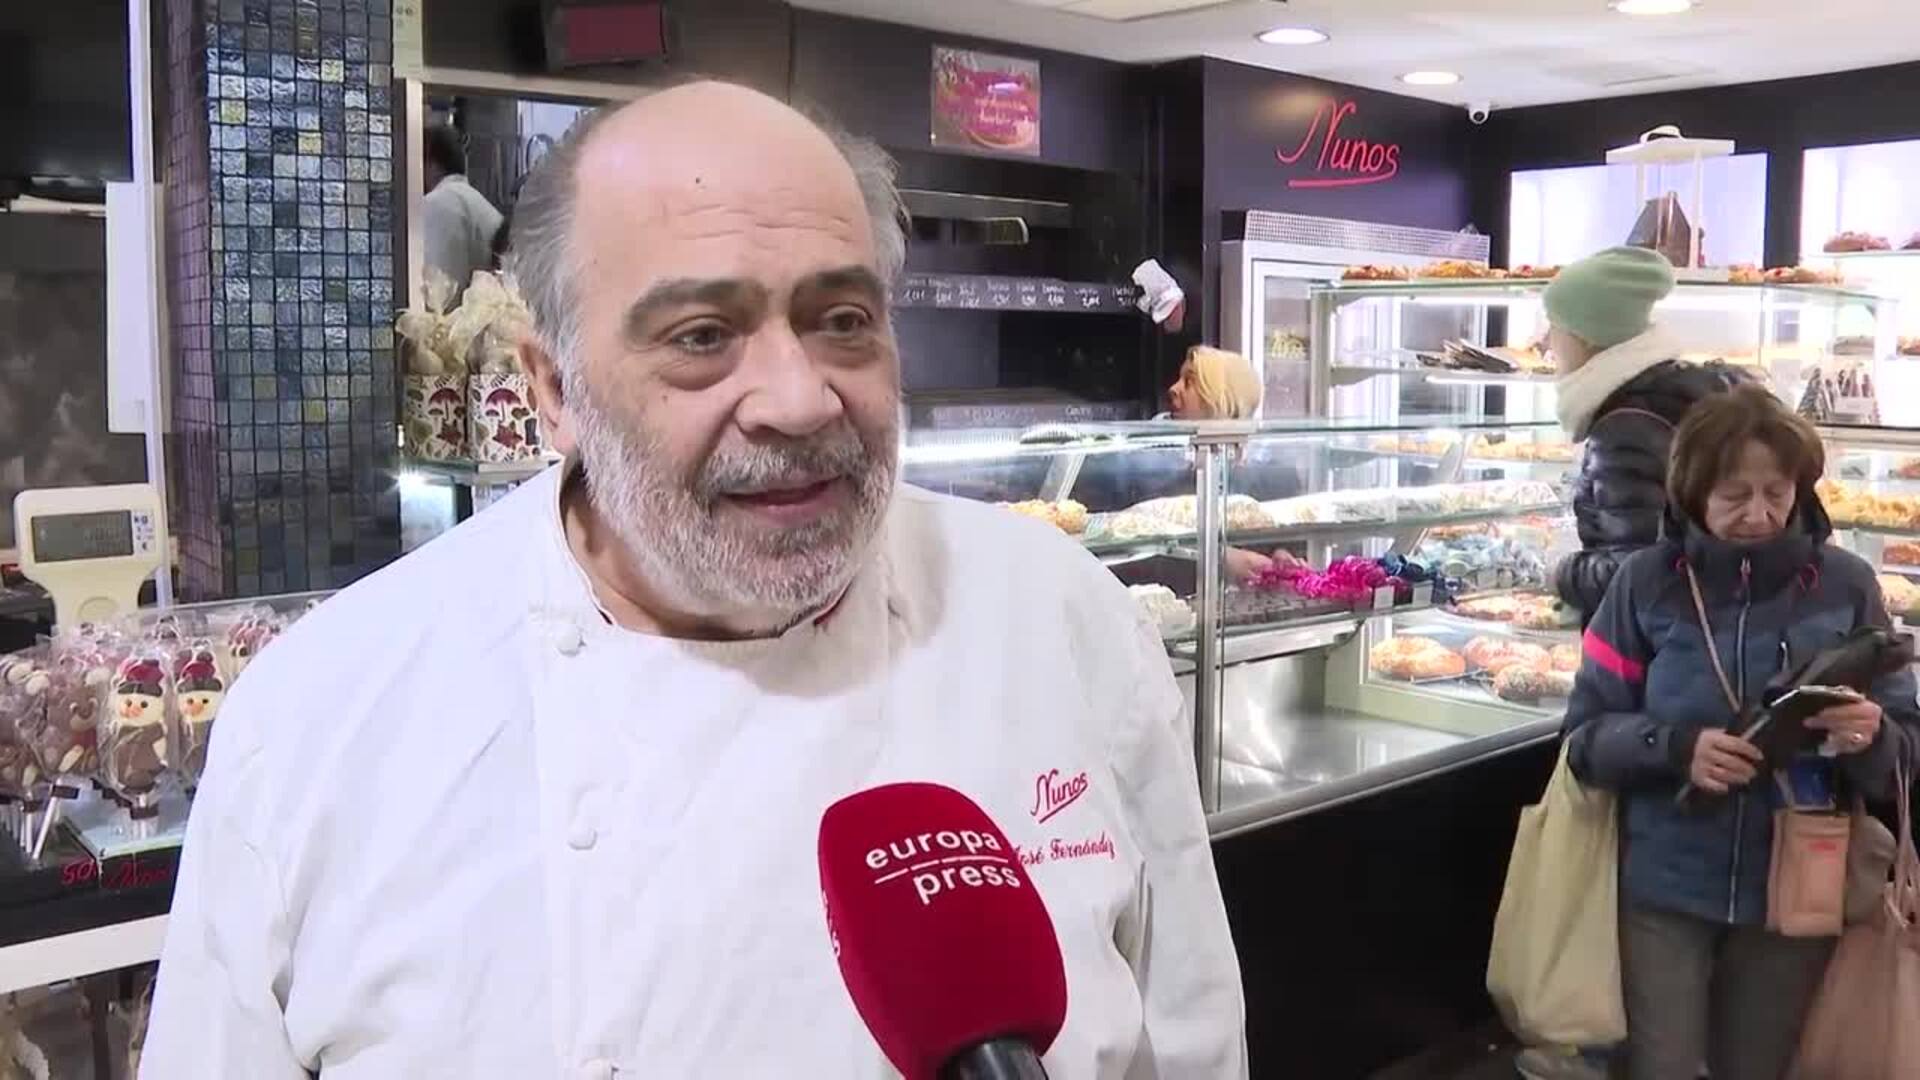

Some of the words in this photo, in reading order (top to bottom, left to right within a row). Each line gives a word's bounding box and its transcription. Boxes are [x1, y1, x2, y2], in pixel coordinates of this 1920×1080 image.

[1276, 97, 1400, 187] Nunos
[1030, 768, 1088, 824] Nunos
[866, 830, 1003, 869] europa
[913, 864, 1021, 905] press
